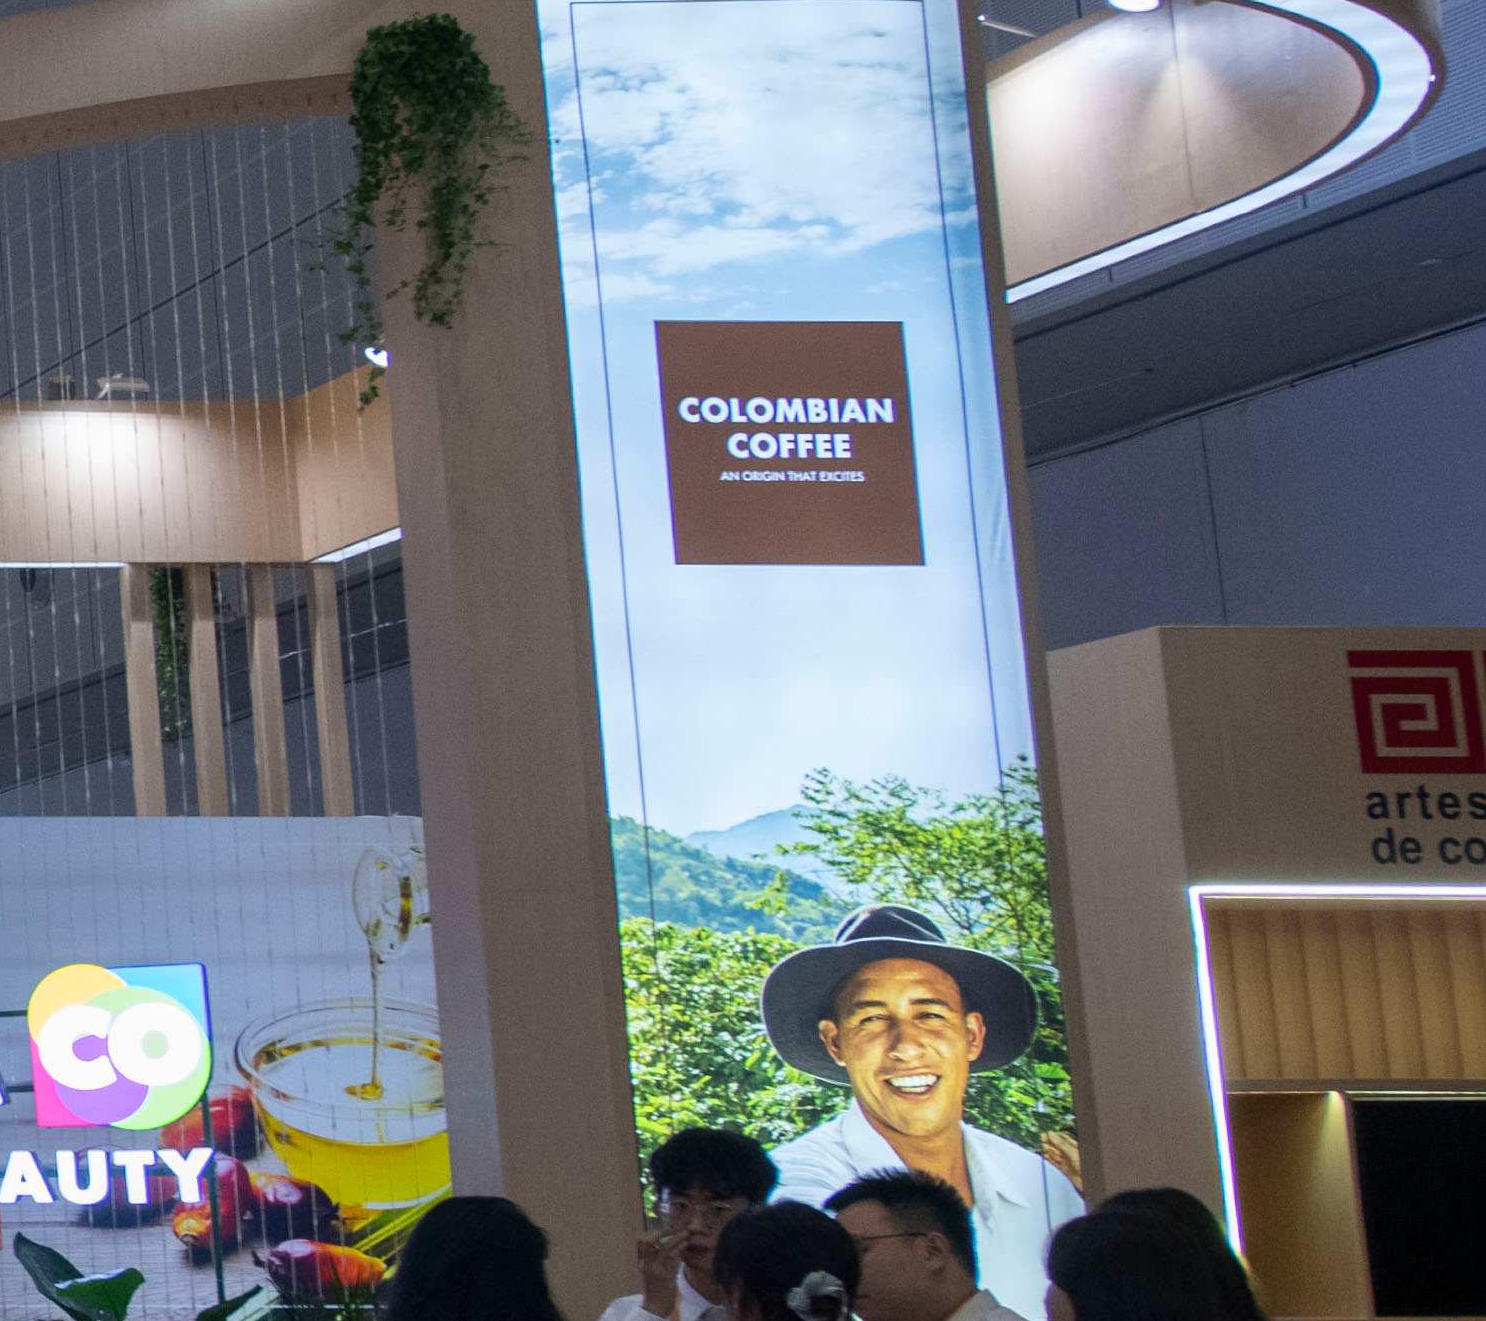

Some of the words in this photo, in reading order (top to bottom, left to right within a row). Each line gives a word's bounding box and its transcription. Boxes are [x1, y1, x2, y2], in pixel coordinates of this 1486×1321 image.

[678, 396, 894, 424] COLOMBIAN
[726, 432, 853, 459] COFFEE
[720, 471, 740, 481] AN
[741, 471, 786, 482] ORIGIN
[788, 471, 818, 481] THAT
[819, 471, 865, 482] EXCITES
[1372, 828, 1423, 865] de
[39, 1001, 202, 1092] CO
